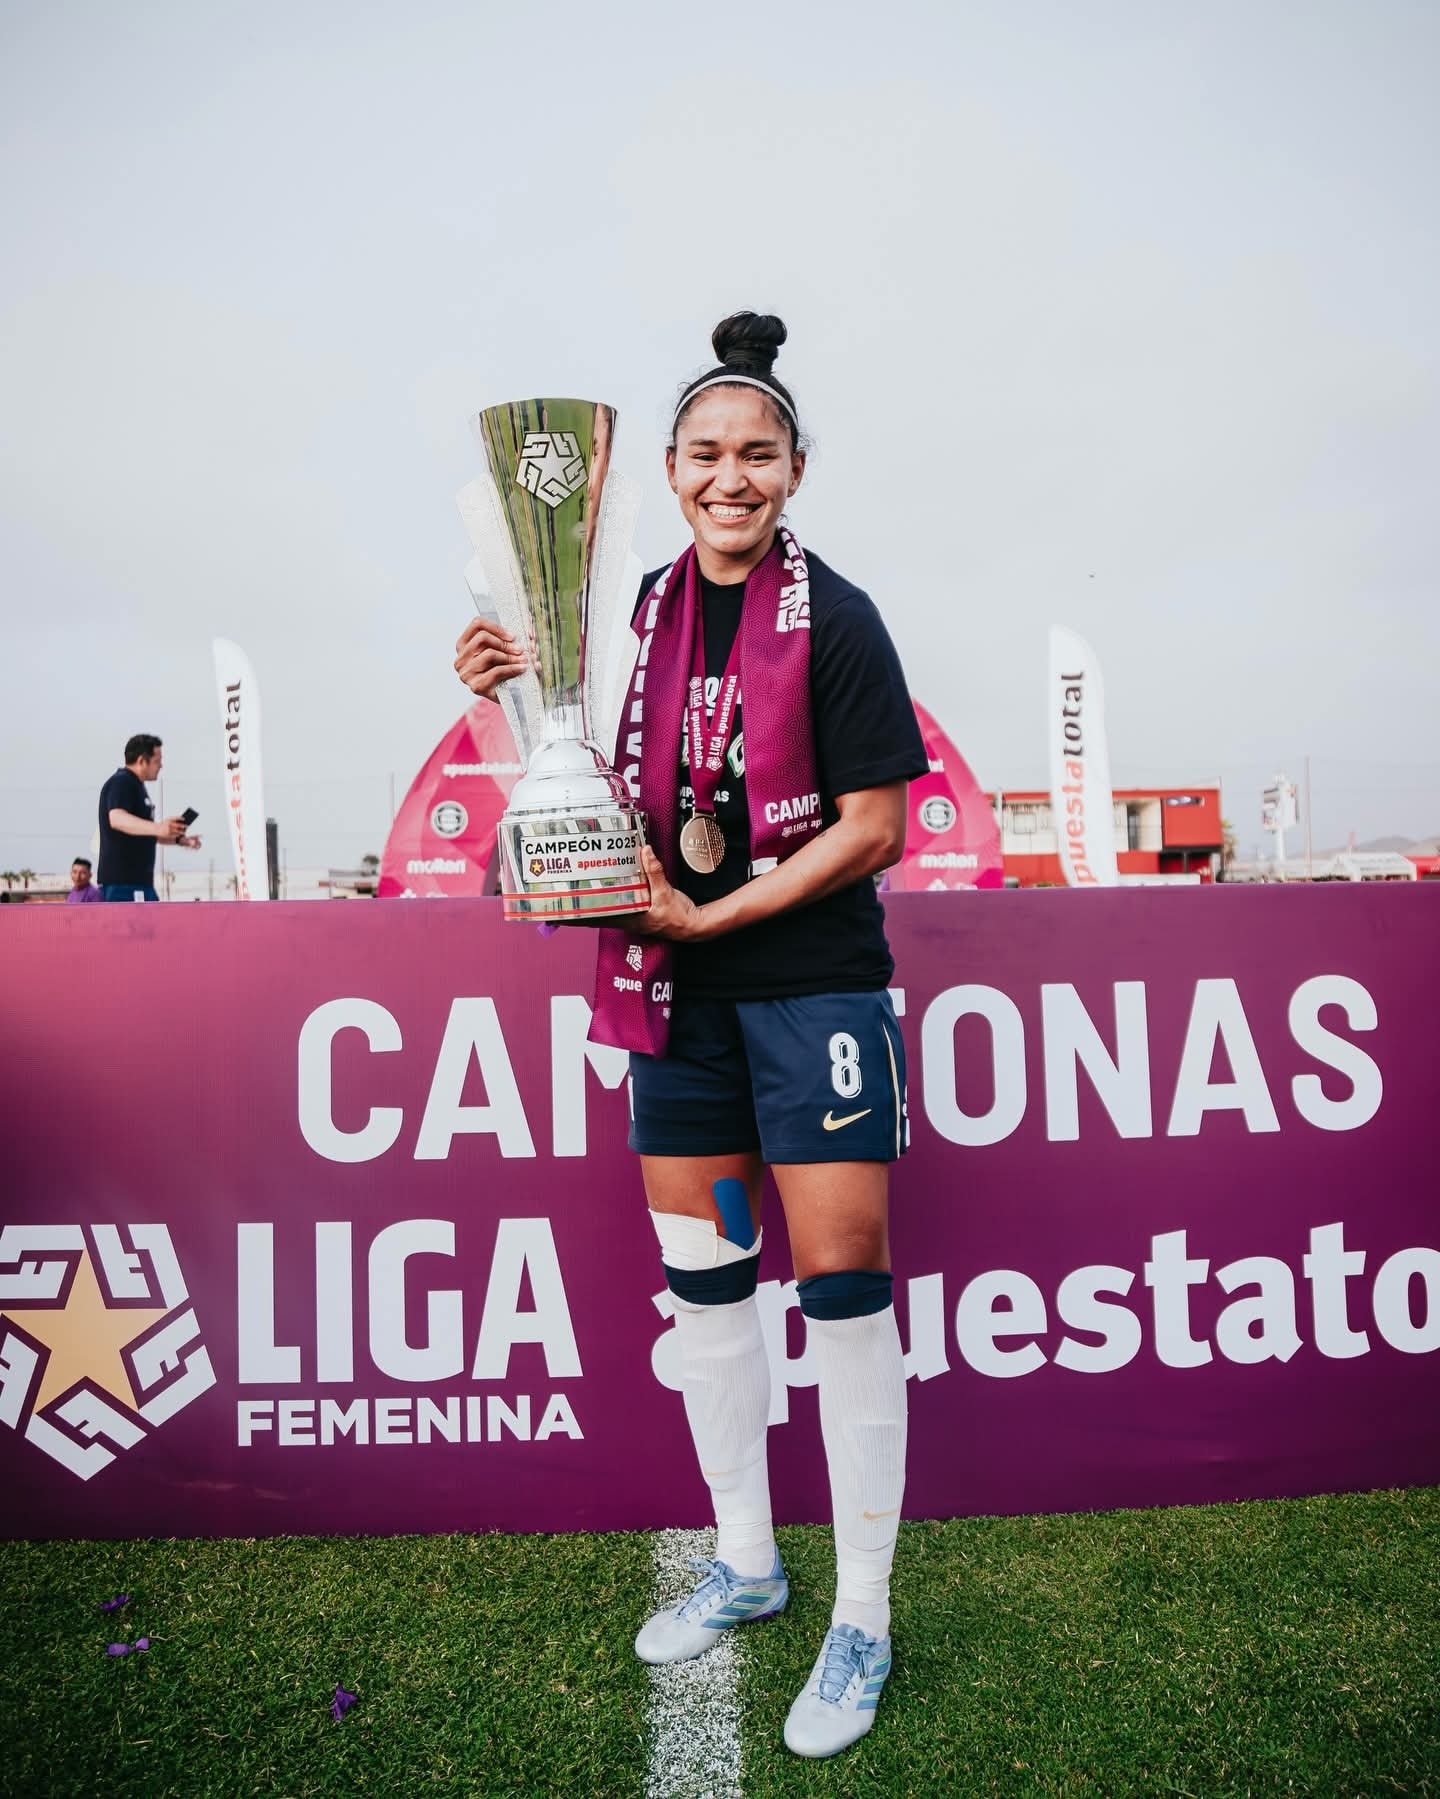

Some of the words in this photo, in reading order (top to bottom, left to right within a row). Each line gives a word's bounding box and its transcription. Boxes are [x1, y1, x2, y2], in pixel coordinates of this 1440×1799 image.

[693, 688, 703, 709] LIGA
[709, 736, 723, 757] LIGA
[718, 675, 738, 734] apuestatotal
[765, 791, 821, 824] CAMP
[525, 836, 602, 855] CAMPEÓN
[607, 836, 636, 850] 2025
[547, 857, 571, 869] LIGA
[577, 856, 636, 871] apuestatotal
[613, 976, 643, 992] apue
[652, 981, 674, 1002] CA
[828, 1031, 862, 1099] 8
[237, 1217, 584, 1384] LIGA
[237, 1393, 585, 1447] FEMENINA
